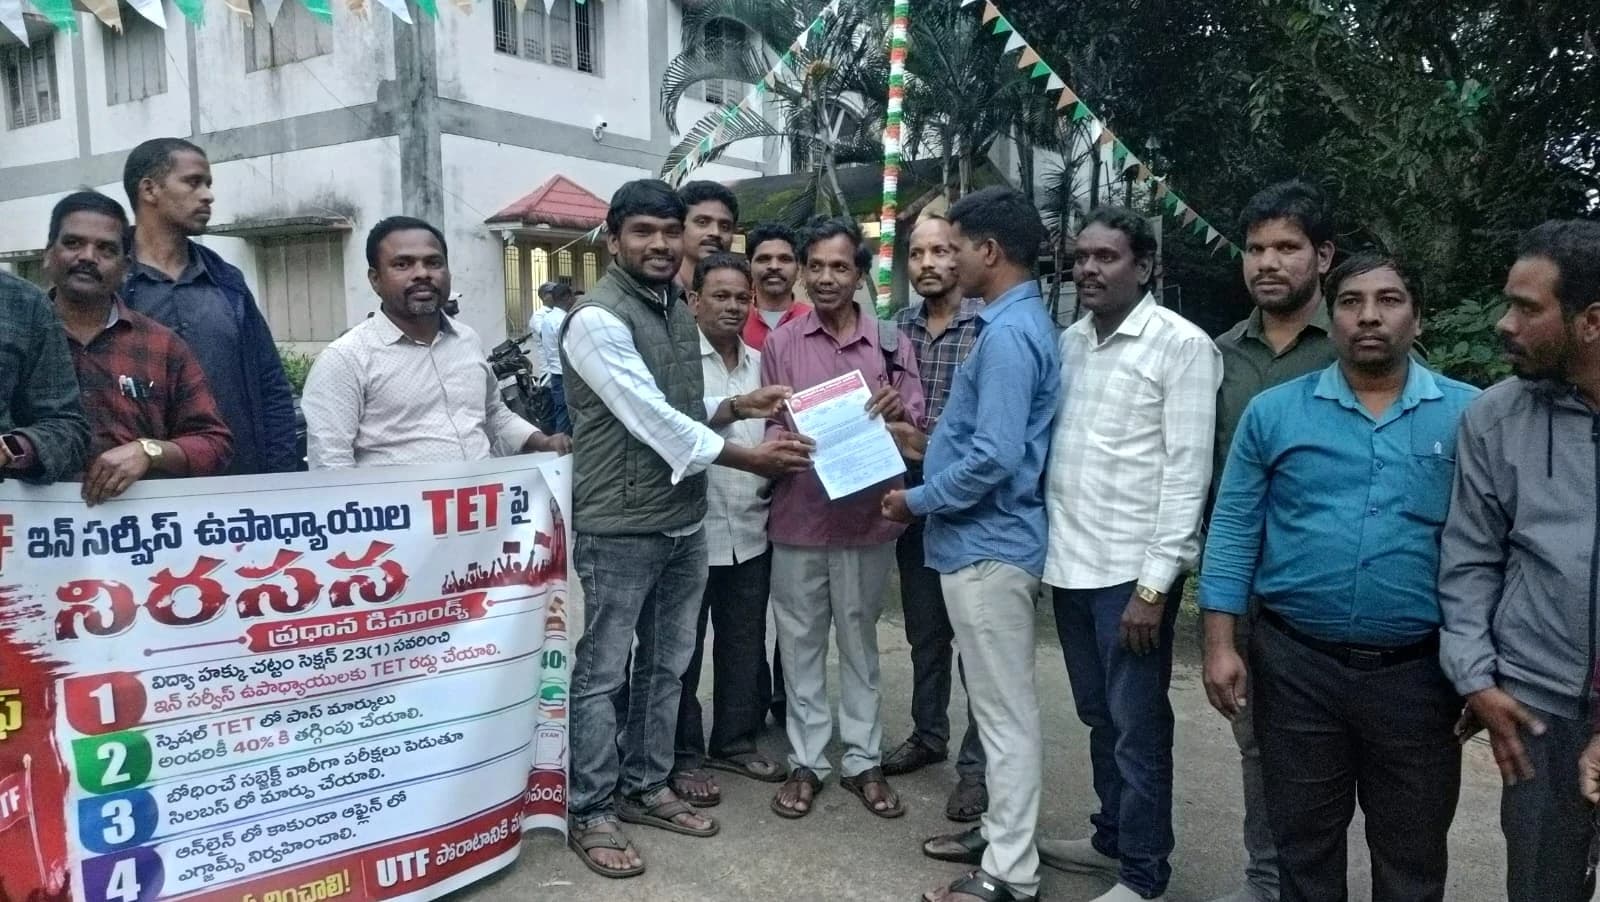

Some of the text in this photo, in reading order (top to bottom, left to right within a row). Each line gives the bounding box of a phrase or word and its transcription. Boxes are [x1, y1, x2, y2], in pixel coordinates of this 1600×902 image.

[28, 517, 74, 558] ఇన్
[82, 511, 182, 565] సర్వీస్
[194, 502, 411, 550] ఉపాధ్యాయుల
[422, 483, 504, 536] TET
[510, 485, 531, 525] పై
[268, 618, 358, 647] ప్రధాన
[152, 631, 450, 690] విద్యా హక్కు చట్టం సెక్షన్ 23(1) సవరించి
[154, 643, 501, 713] ఇన్ సర్వీస్ ఉపాధ్యాయులకు TET రద్దు చేయాలి.
[89, 683, 116, 725] 1
[155, 694, 396, 750] స్పెషల్ TET లో పాస్ మార్కులు
[233, 736, 274, 754] 40%
[278, 730, 290, 745] కి
[294, 720, 354, 745] తగ్గింపు
[358, 707, 423, 728] చేయాలి.
[97, 741, 131, 786] 2
[167, 775, 236, 804] బోధించే
[286, 757, 340, 778] వారీగా
[344, 746, 401, 766] పరీక్షలు
[404, 731, 463, 753] పెడుతూ
[0, 786, 20, 819] TF
[102, 798, 136, 845] 3
[168, 767, 385, 826] సిలబస్ లో మార్పు చేయాలి.
[241, 824, 262, 843] లో
[266, 811, 337, 836] కాకుండా
[387, 790, 407, 807] లో
[248, 827, 356, 864] నిర్వహించాలి.
[376, 848, 430, 888] UTF
[436, 818, 508, 866] పోరాటానికి
[106, 857, 141, 902] 4
